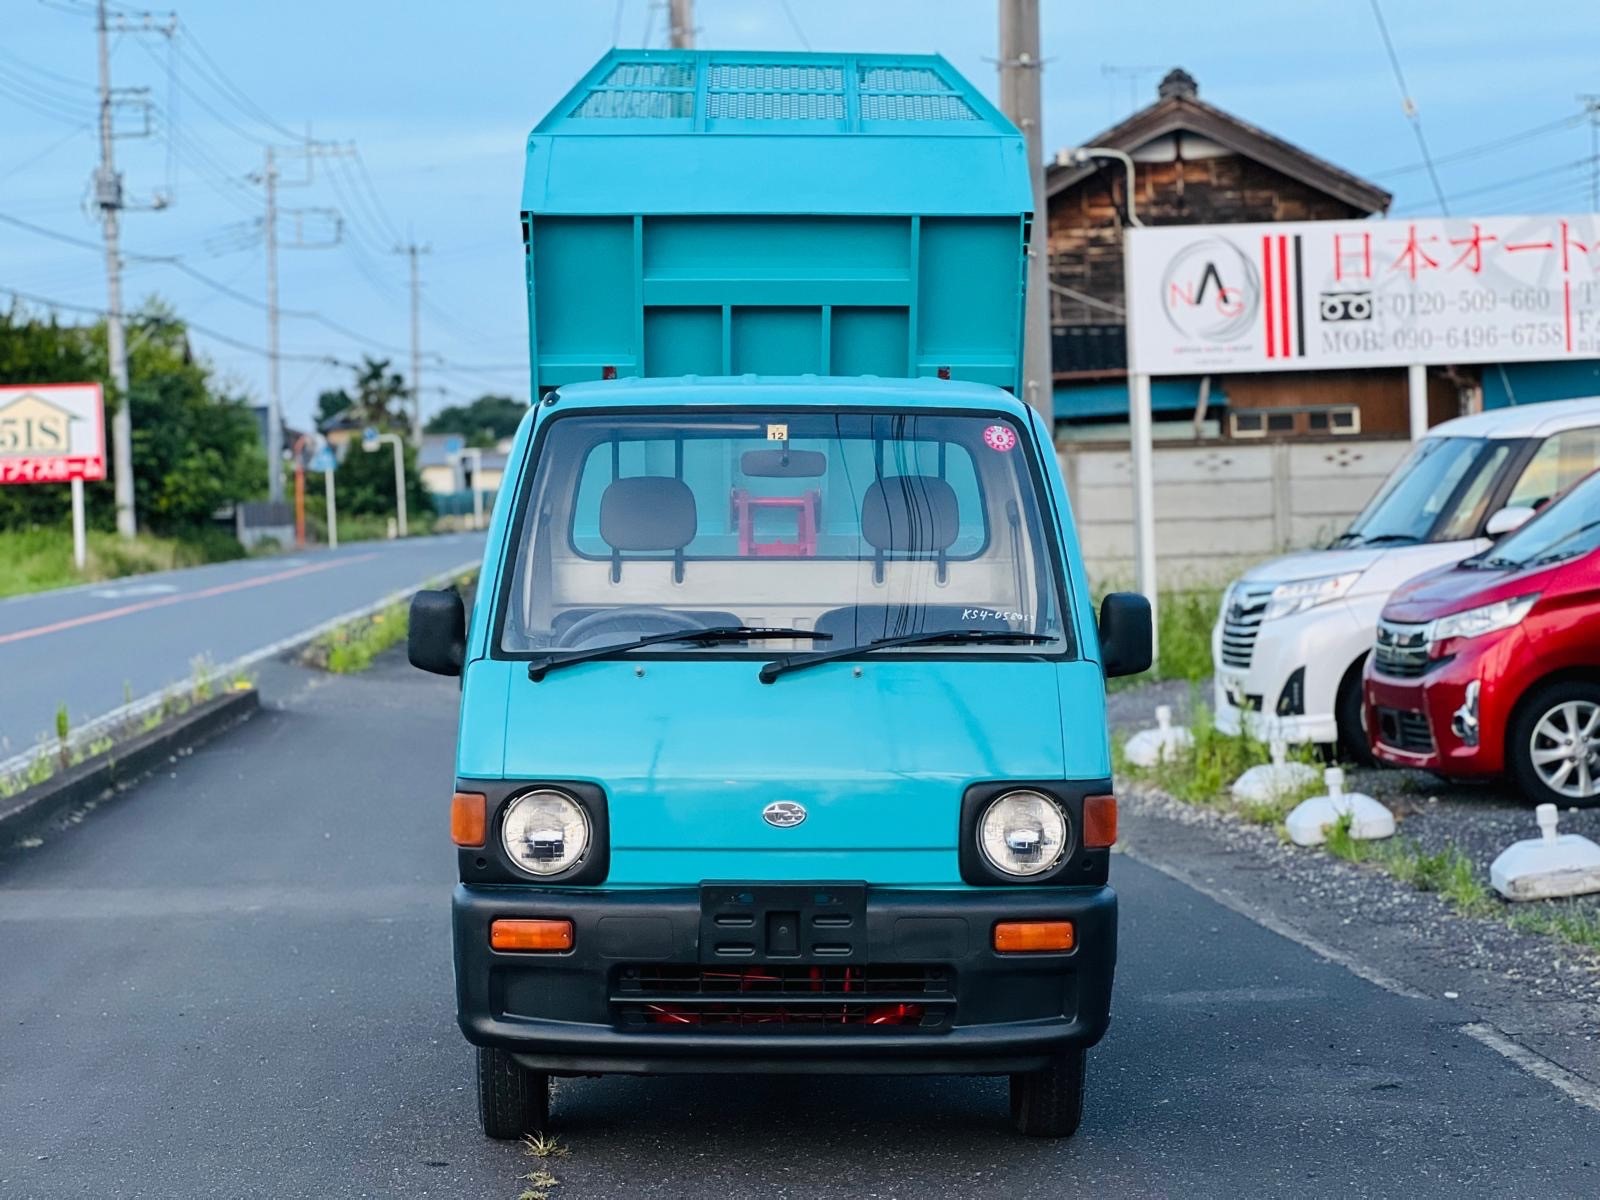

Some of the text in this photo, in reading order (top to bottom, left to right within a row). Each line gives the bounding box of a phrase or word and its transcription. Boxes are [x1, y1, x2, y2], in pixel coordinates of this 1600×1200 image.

[1333, 219, 1600, 282] 日本オート
[771, 432, 784, 440] 12
